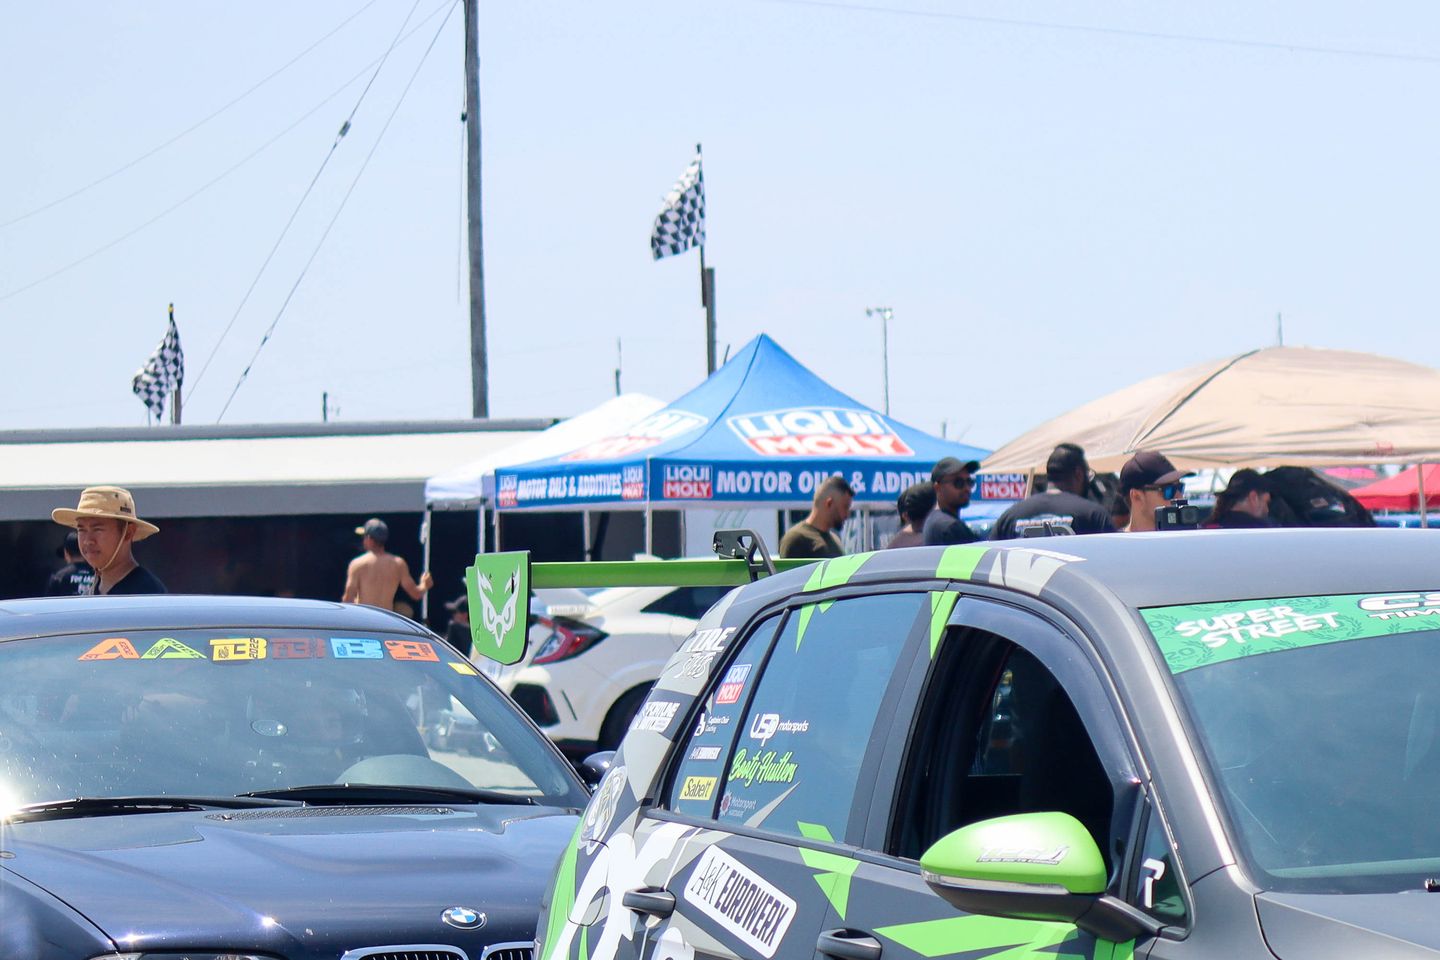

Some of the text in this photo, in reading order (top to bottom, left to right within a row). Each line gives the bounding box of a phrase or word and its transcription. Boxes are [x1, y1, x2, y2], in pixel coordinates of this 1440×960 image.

[744, 412, 878, 436] LIQUI
[756, 435, 902, 455] MOLY
[517, 477, 547, 500] MOTOR
[547, 476, 567, 498] OILS
[577, 473, 622, 497] ADDITIVES
[622, 466, 644, 482] LIQUI
[665, 467, 710, 481] LIQUI
[716, 471, 791, 493] MOTOR
[852, 471, 866, 492] &
[665, 483, 1025, 497] MOLY MOLY
[1174, 606, 1300, 637] SUPER
[1202, 612, 1341, 648] STREET
[714, 869, 790, 947] EUROWERX
